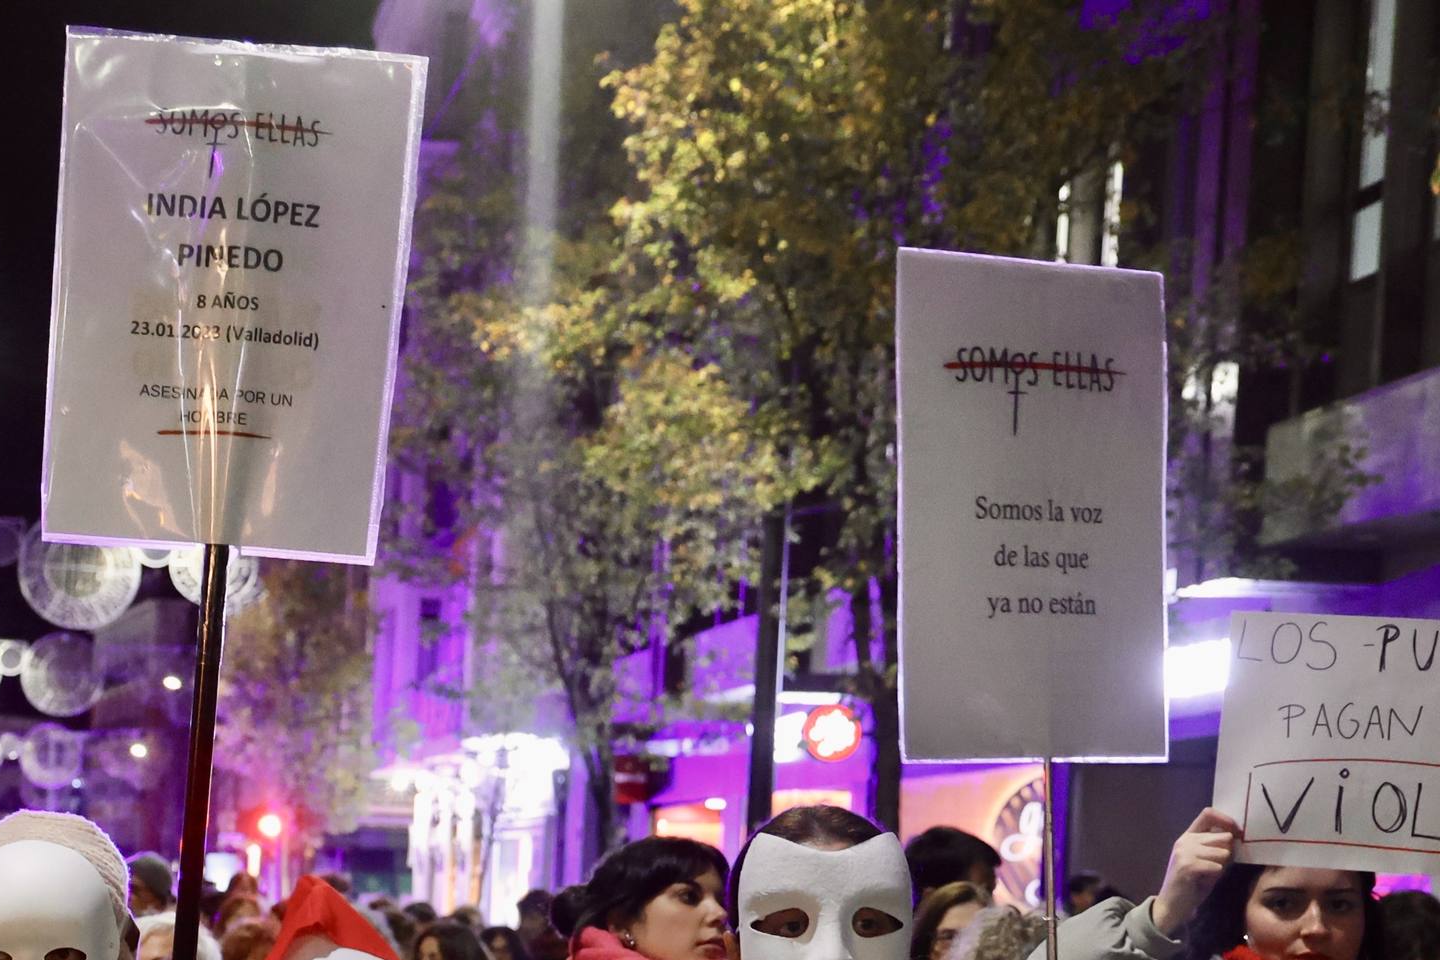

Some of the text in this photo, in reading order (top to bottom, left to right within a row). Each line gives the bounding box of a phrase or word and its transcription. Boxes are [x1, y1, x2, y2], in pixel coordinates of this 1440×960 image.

[155, 109, 321, 147] SOMOS ELLAS
[147, 193, 321, 228] INDIA LÓPEZ
[177, 244, 283, 272] PINEDO
[196, 291, 259, 311] 8 AÑOS
[225, 325, 320, 350] (Valladolid)
[955, 346, 1115, 392] SOMOS ELLAS
[236, 388, 266, 405] POR
[270, 393, 293, 407] UN
[180, 410, 248, 426] HOBRE
[975, 496, 1103, 524] Somos la voz
[994, 544, 1089, 574] de las que
[987, 592, 1097, 619] ya no están
[1236, 619, 1338, 671] LOS
[1278, 702, 1423, 741] PAGAN
